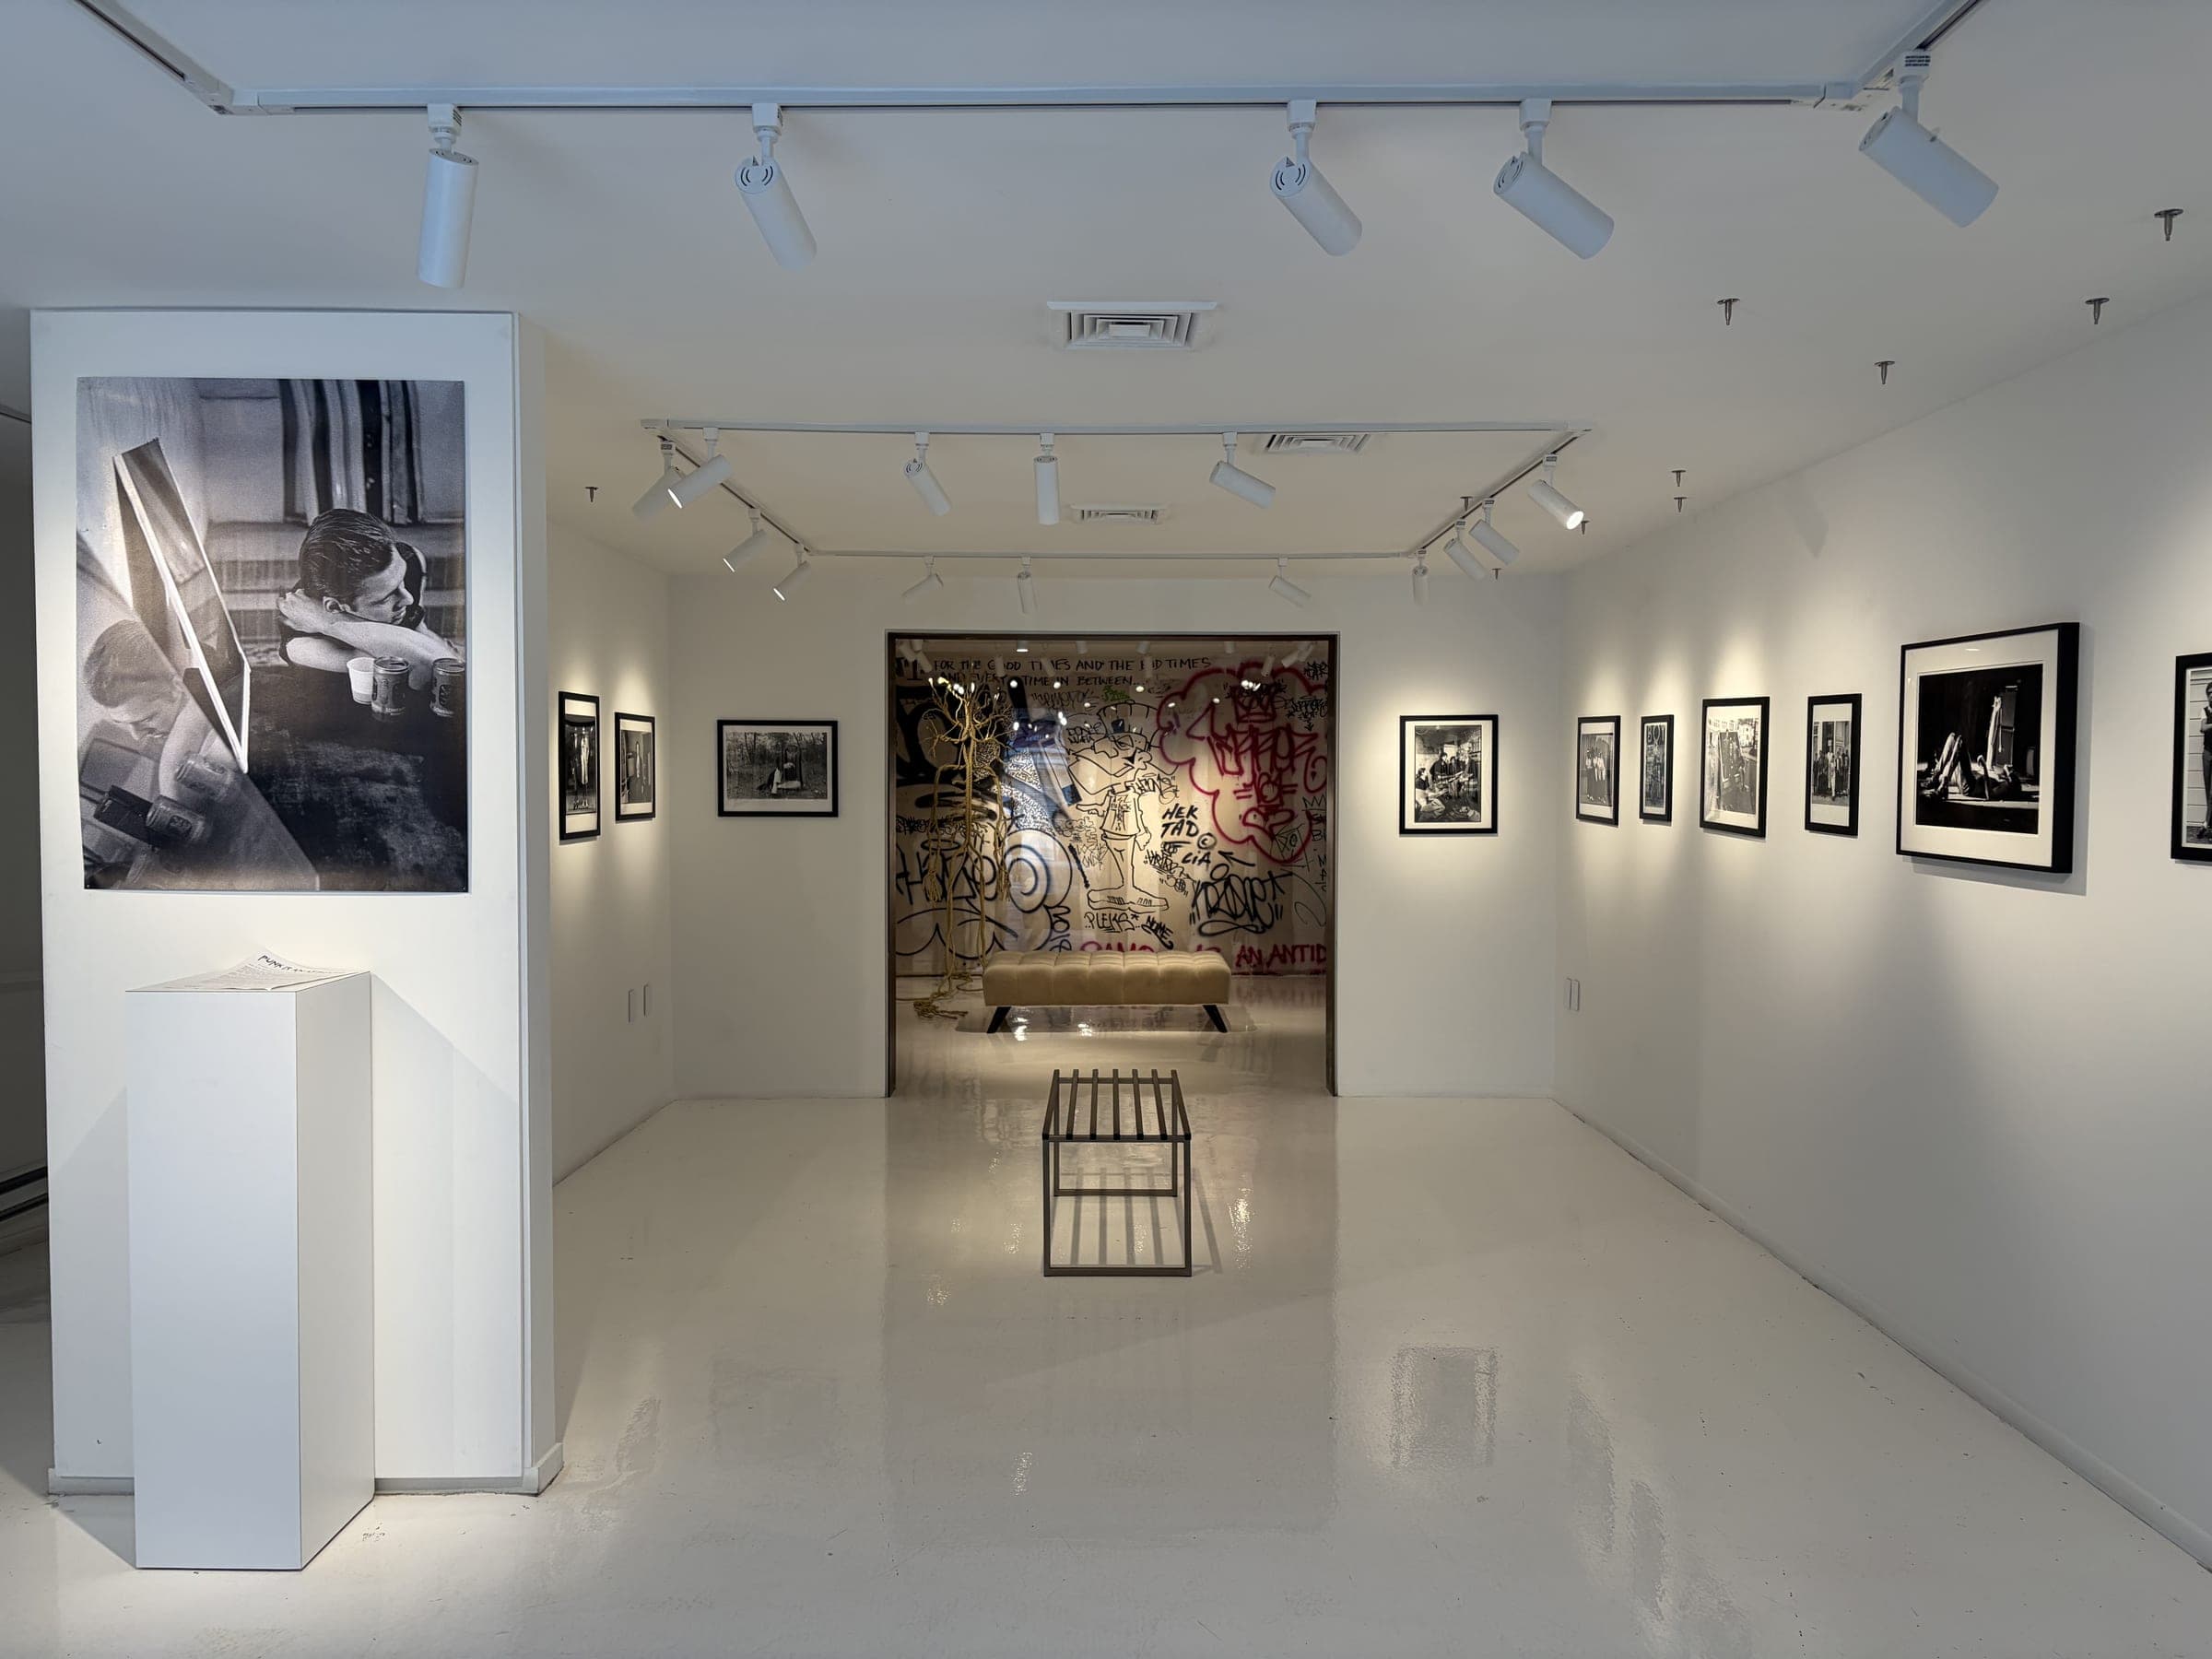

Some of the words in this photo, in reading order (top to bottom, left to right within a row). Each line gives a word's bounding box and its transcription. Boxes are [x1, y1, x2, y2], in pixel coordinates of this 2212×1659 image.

[934, 660, 955, 670] FOR
[987, 660, 1021, 671] GOD
[1076, 659, 1104, 671] AND
[1109, 660, 1134, 671] THE
[1165, 657, 1212, 669] TIMES
[1022, 675, 1050, 687] TIME
[1162, 803, 1199, 820] HEK
[1160, 818, 1200, 839] TAD
[1235, 945, 1263, 967] AN
